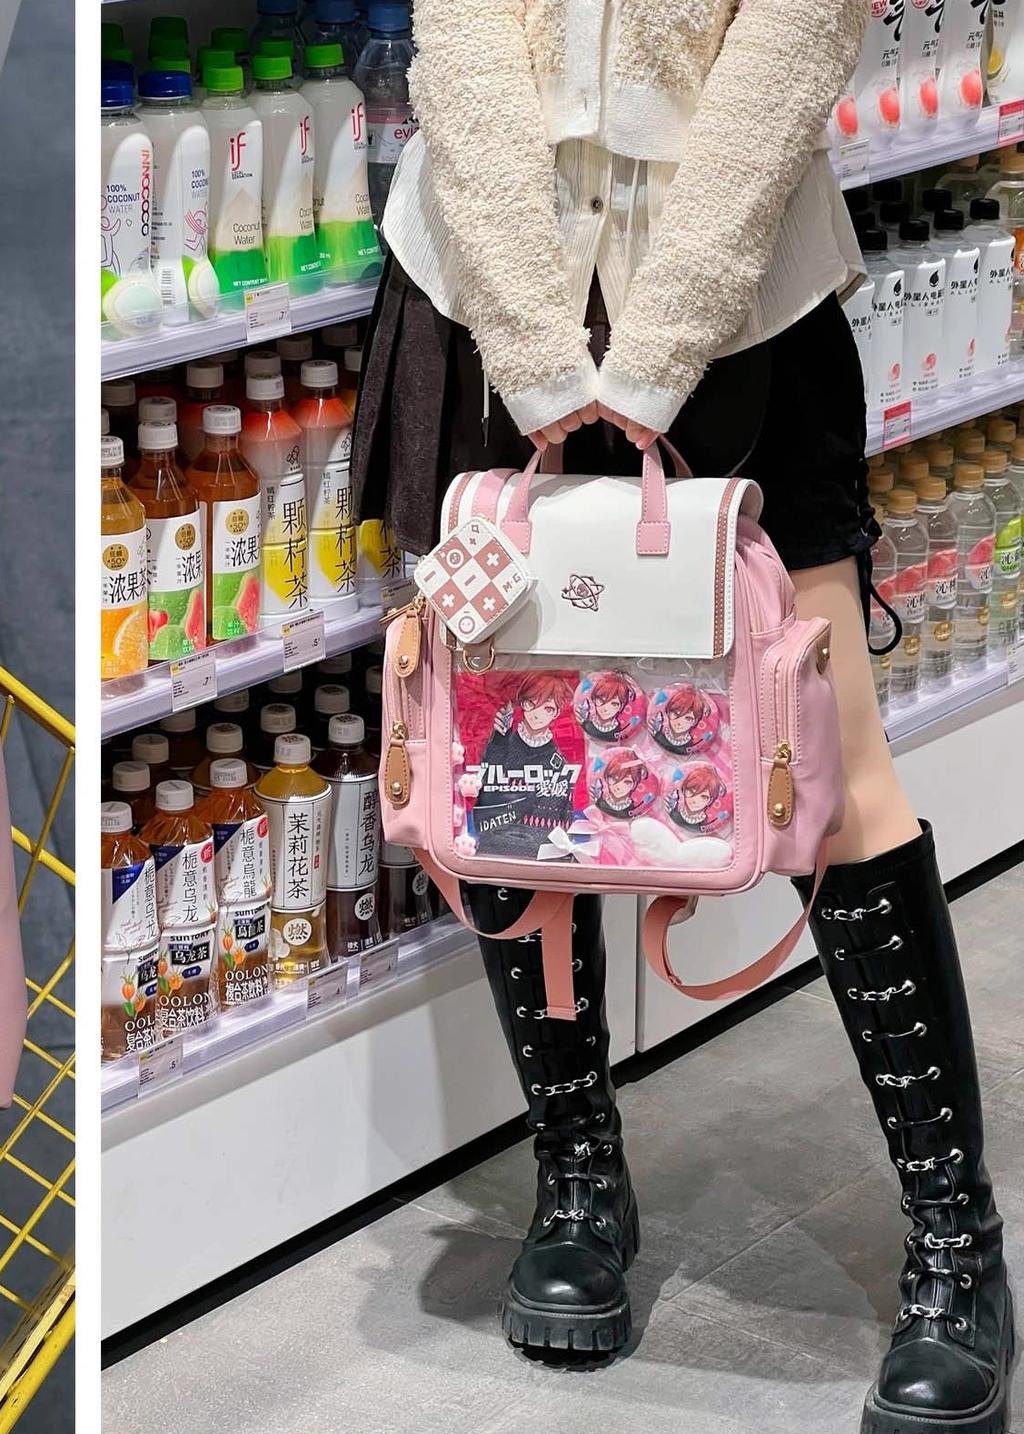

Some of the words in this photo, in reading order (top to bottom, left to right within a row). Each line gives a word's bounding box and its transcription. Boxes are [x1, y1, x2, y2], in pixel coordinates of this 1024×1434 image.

[351, 102, 363, 142] if
[299, 115, 310, 156] if
[229, 132, 247, 172] if
[107, 184, 127, 193] 100%
[107, 192, 140, 203] COCONUT
[233, 222, 261, 234] Coconut
[233, 234, 256, 246] Water
[230, 535, 260, 568] 浓果
[466, 762, 582, 785] ブルーロック
[480, 811, 517, 832] IDATEN
[287, 812, 310, 899] 茉莉花茶
[182, 852, 199, 924] 栀意乌龙
[288, 920, 308, 940] 燃
[174, 950, 208, 965] 乌龙茶
[124, 1018, 156, 1033] OOL
[125, 1027, 154, 1053] 复合茶
